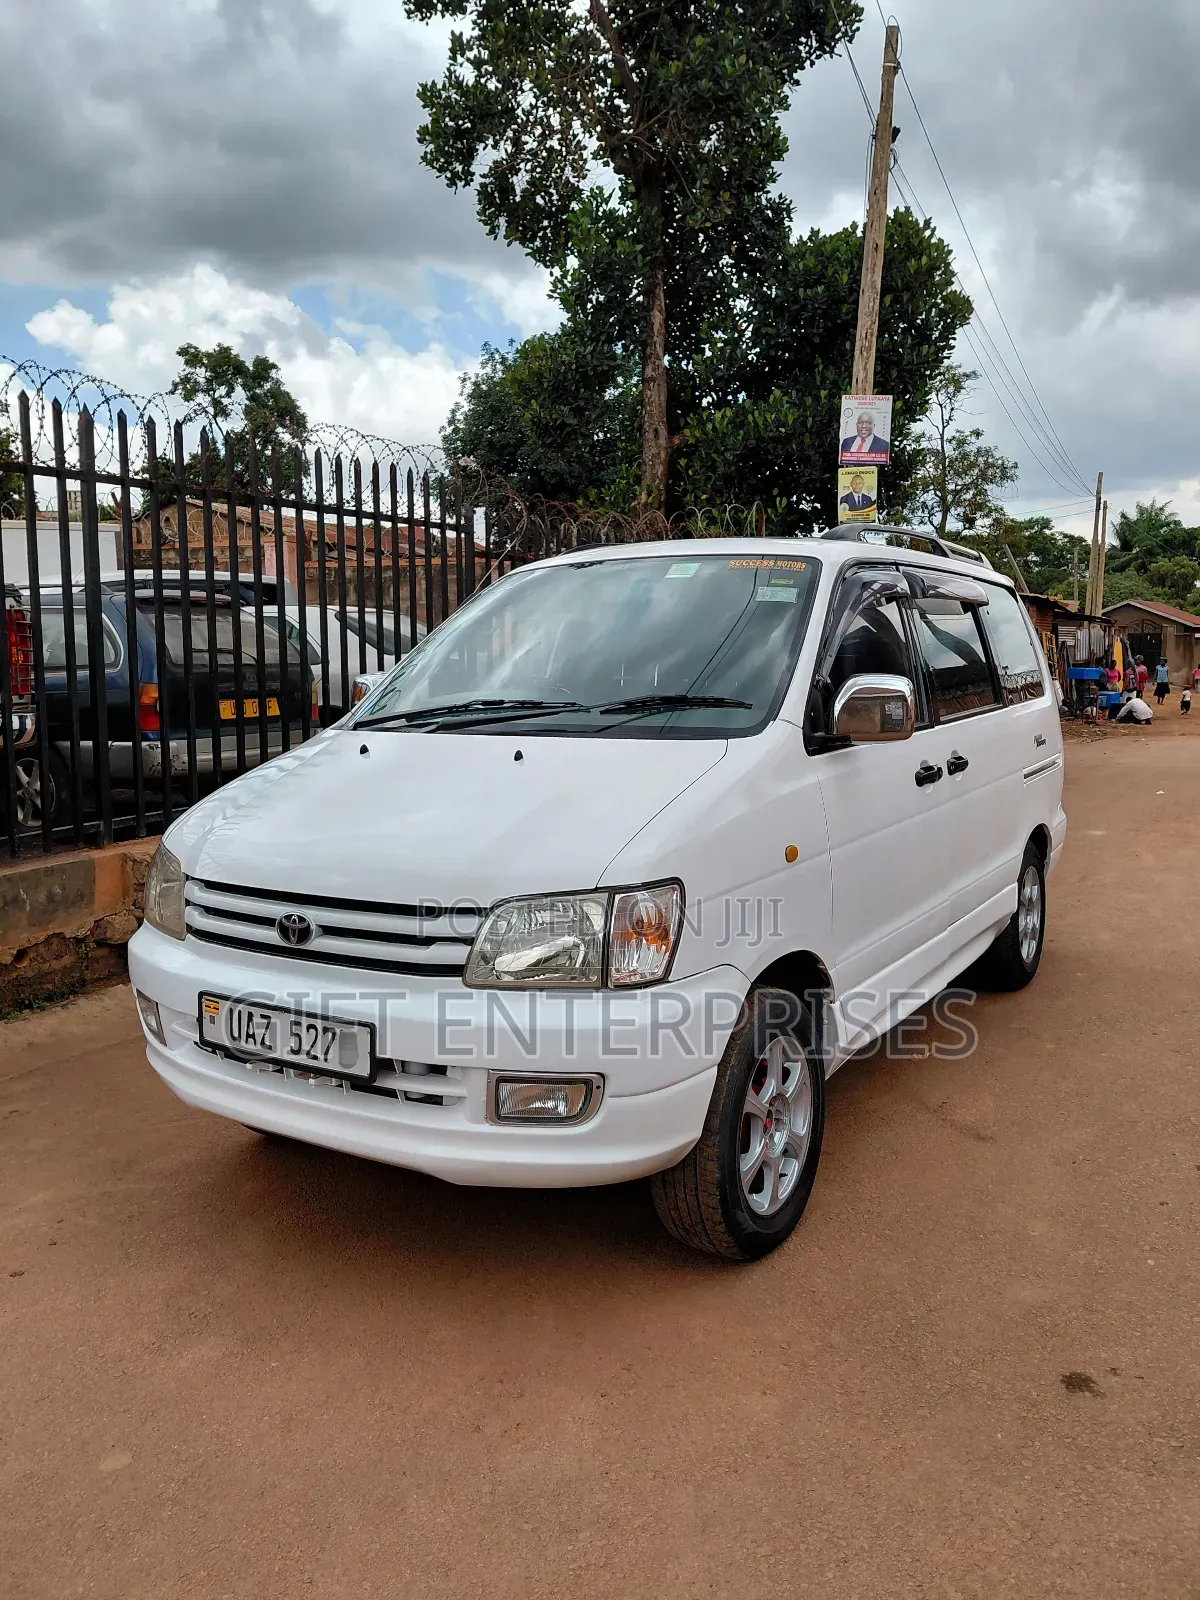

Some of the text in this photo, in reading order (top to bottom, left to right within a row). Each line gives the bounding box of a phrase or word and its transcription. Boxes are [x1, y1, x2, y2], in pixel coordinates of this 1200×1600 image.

[776, 561, 807, 569] MOTORS
[229, 1006, 359, 1069] UAZ 527
